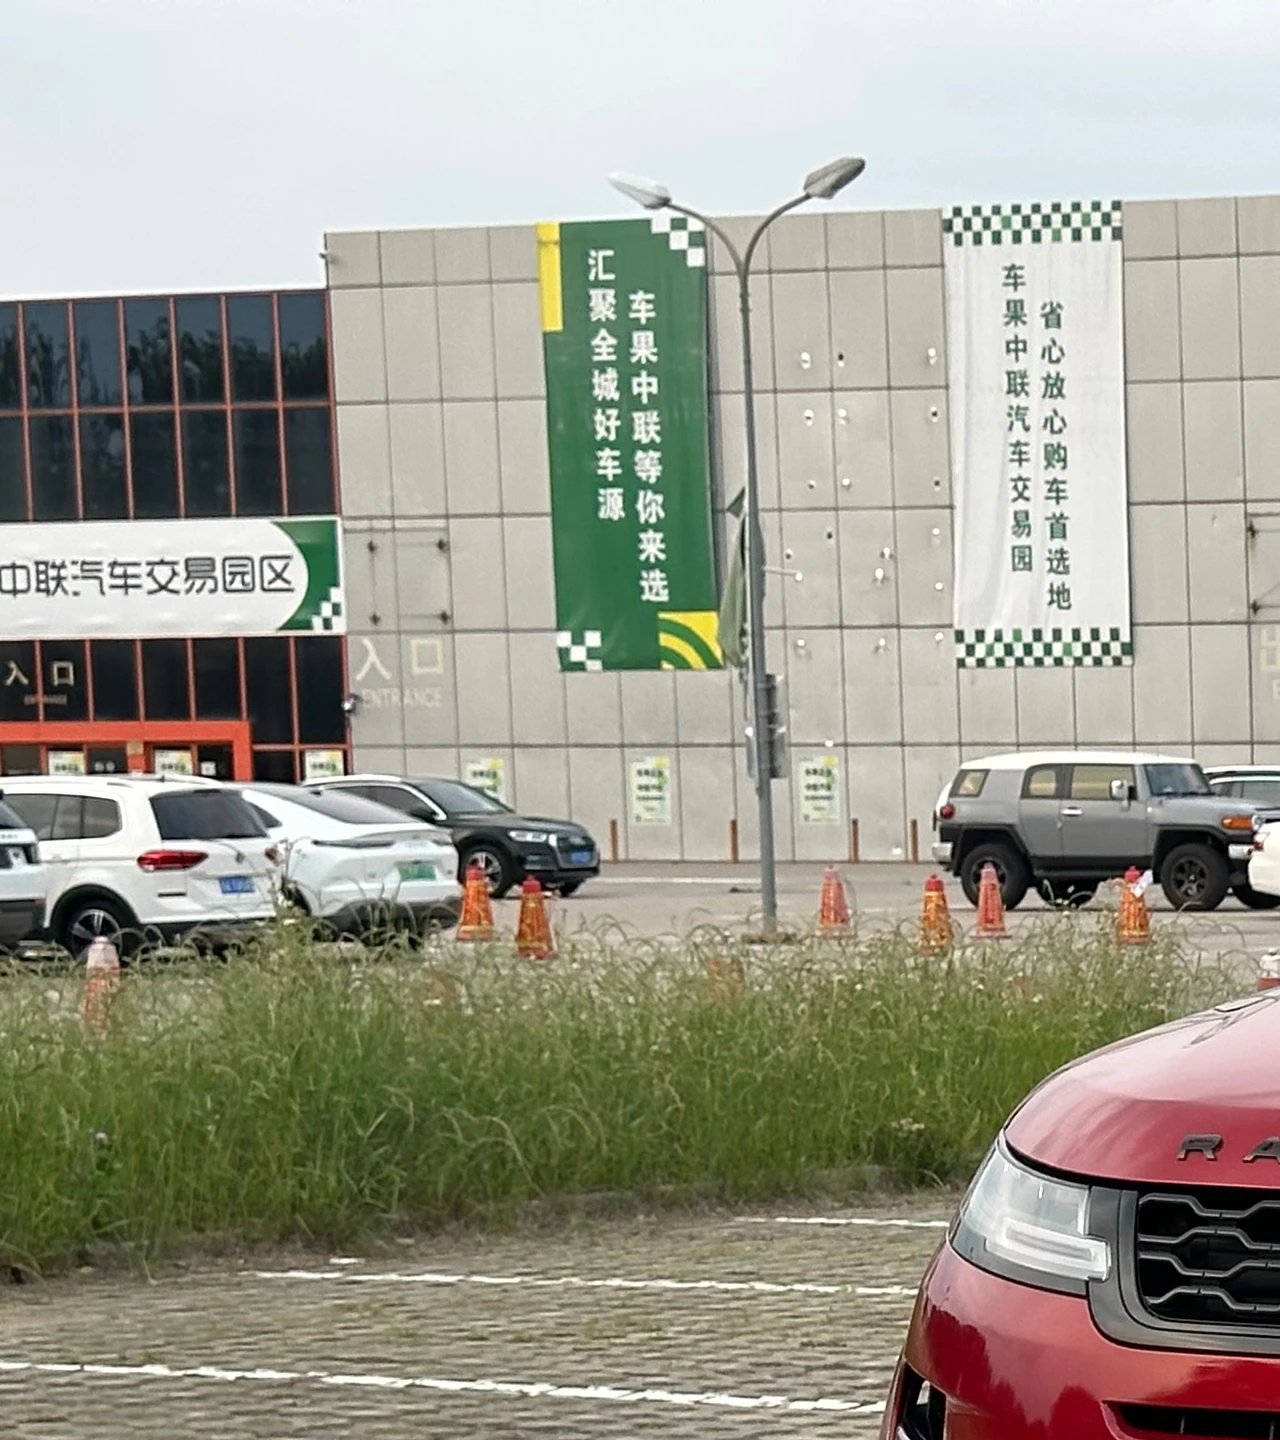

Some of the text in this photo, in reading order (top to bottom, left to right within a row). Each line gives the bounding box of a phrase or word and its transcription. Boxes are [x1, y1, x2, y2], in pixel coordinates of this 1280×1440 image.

[588, 249, 625, 521] 汇聚全城好车源
[629, 290, 669, 602] 车果中联等你来选
[1002, 263, 1033, 572] 车果中联汽车交易园
[1040, 301, 1072, 610] 省心放心购车首选地
[0, 555, 295, 597] 中联汽车交易园区
[5, 661, 74, 687] 入口
[356, 638, 443, 680] 入口
